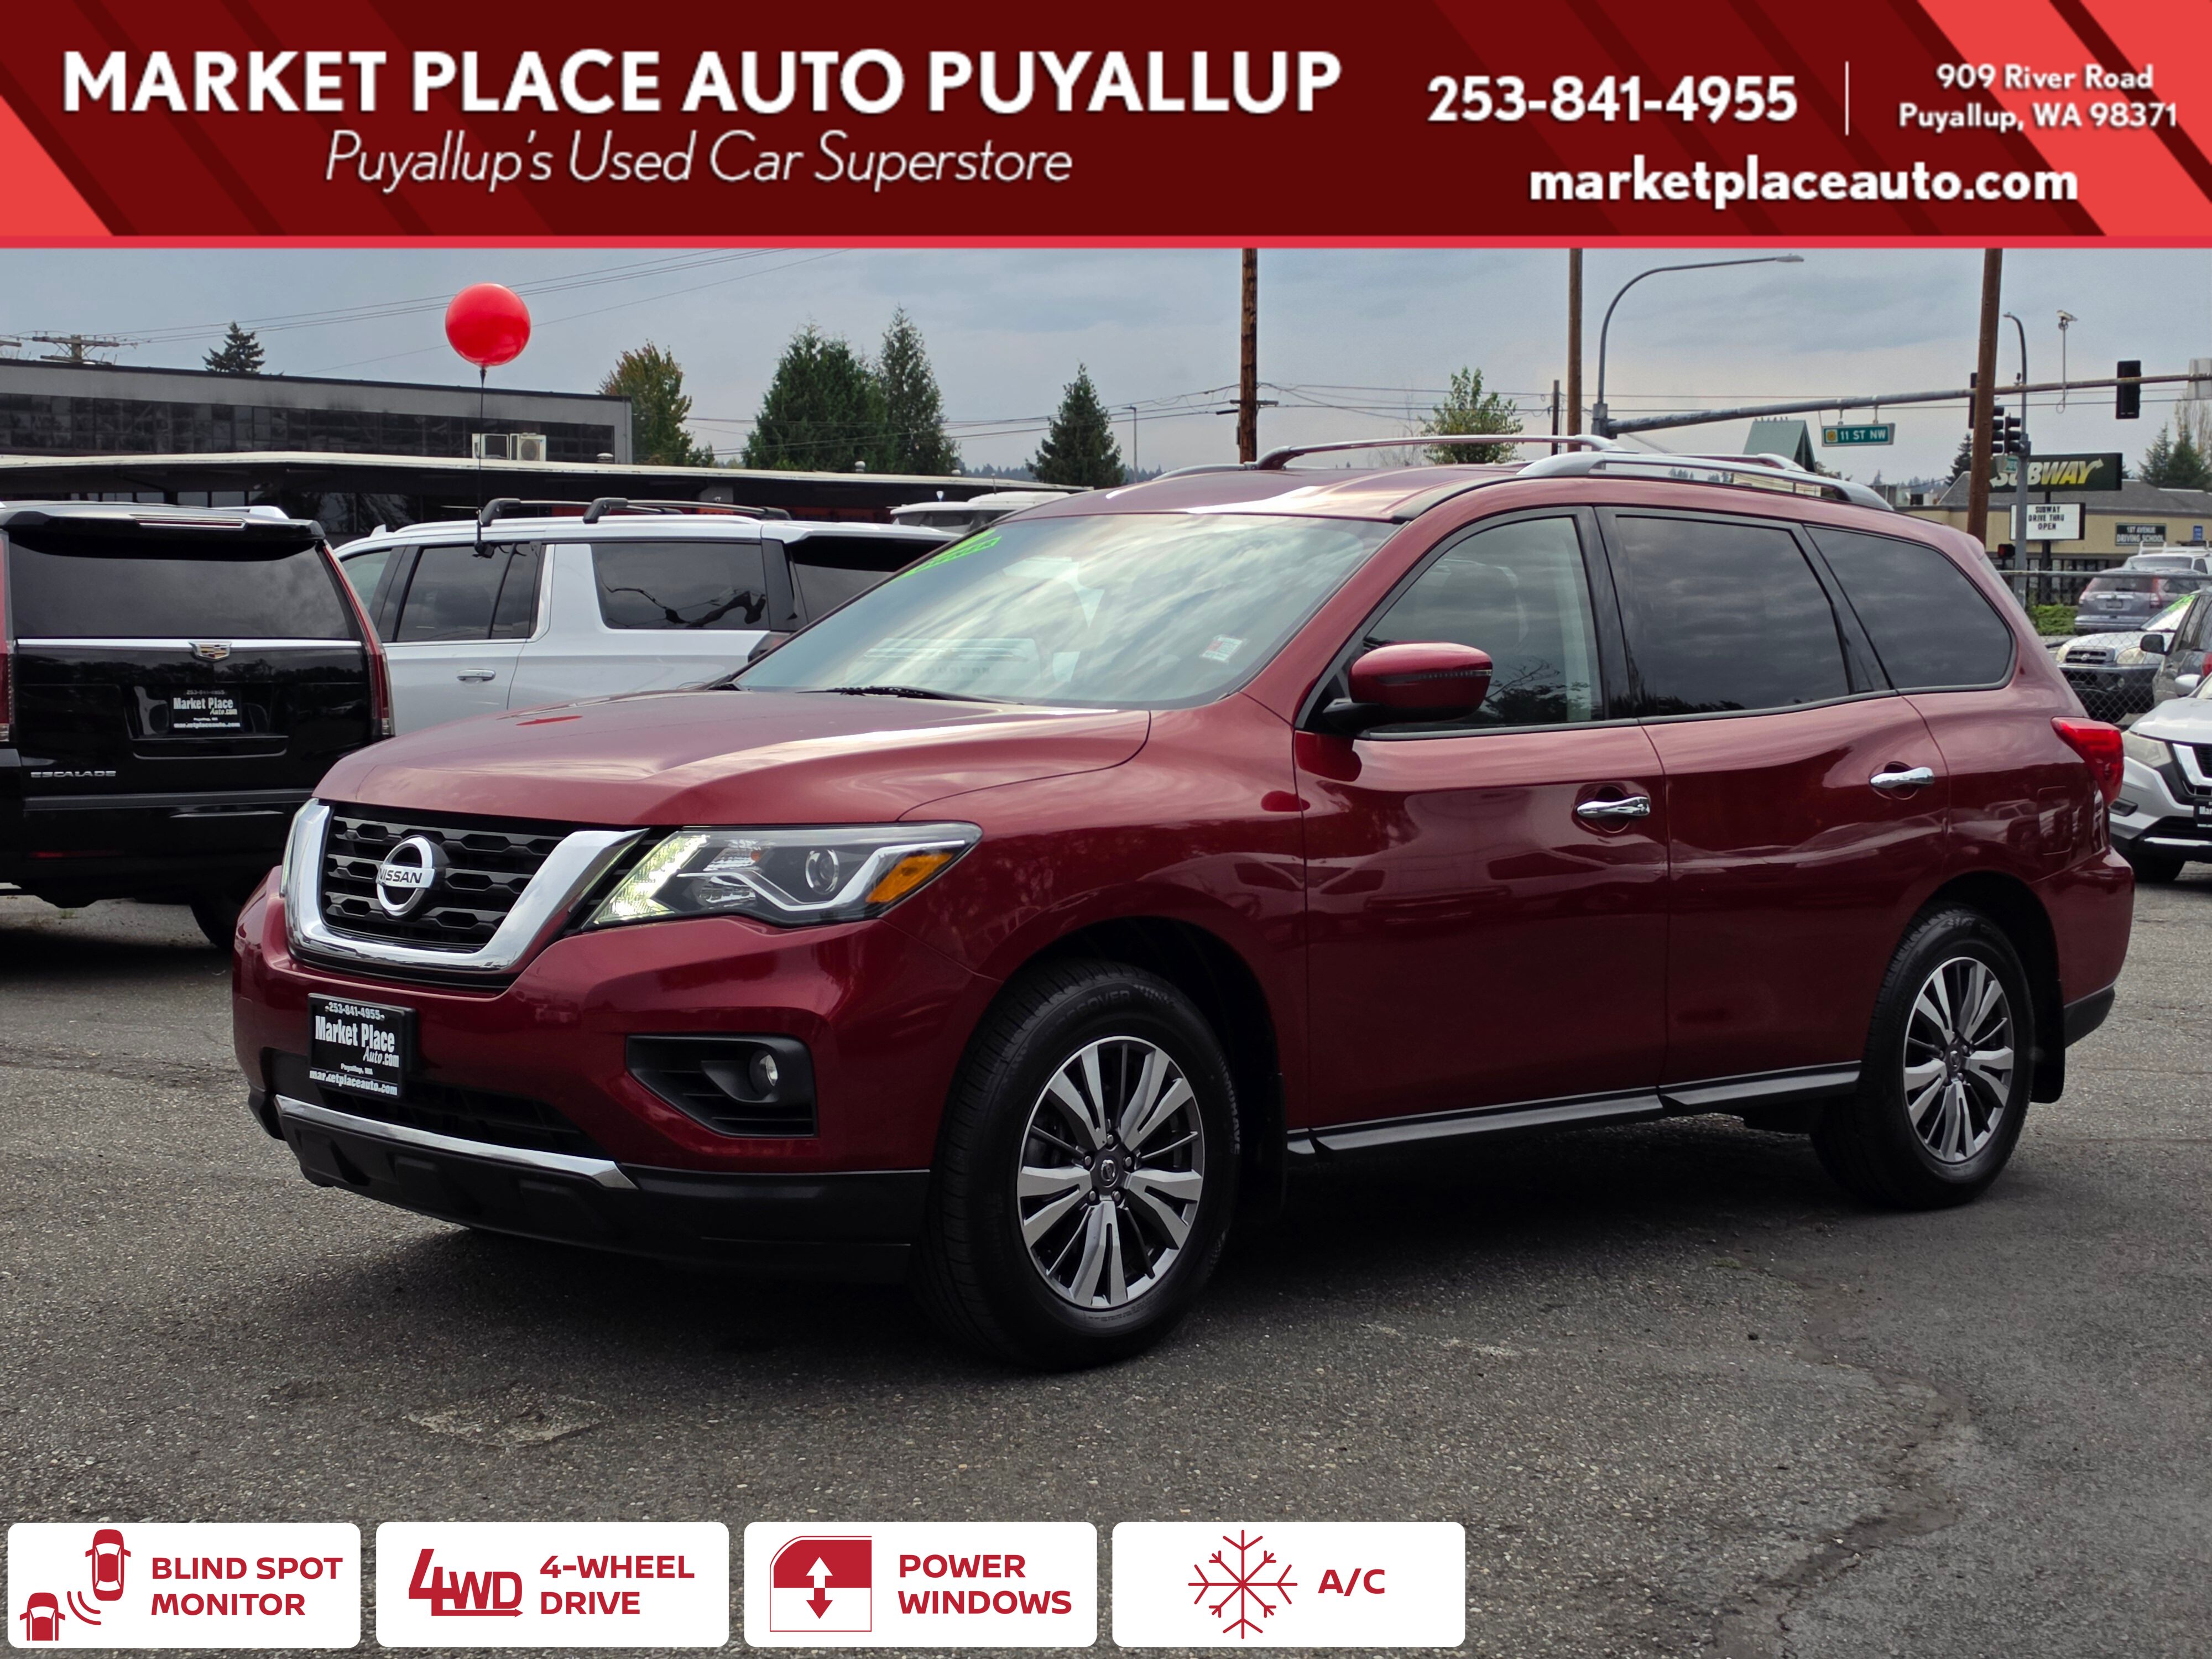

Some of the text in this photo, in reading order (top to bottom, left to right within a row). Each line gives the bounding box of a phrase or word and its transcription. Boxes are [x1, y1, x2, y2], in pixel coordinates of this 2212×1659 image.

[1840, 429, 1886, 440] 11 ST NW
[2116, 534, 2141, 542] DRIVING
[173, 697, 233, 709] Market Place
[379, 868, 422, 884] NISSAN
[328, 1001, 380, 1021] 253-841-4955
[315, 1015, 395, 1052] Market Place
[363, 1046, 399, 1067] Auto.com
